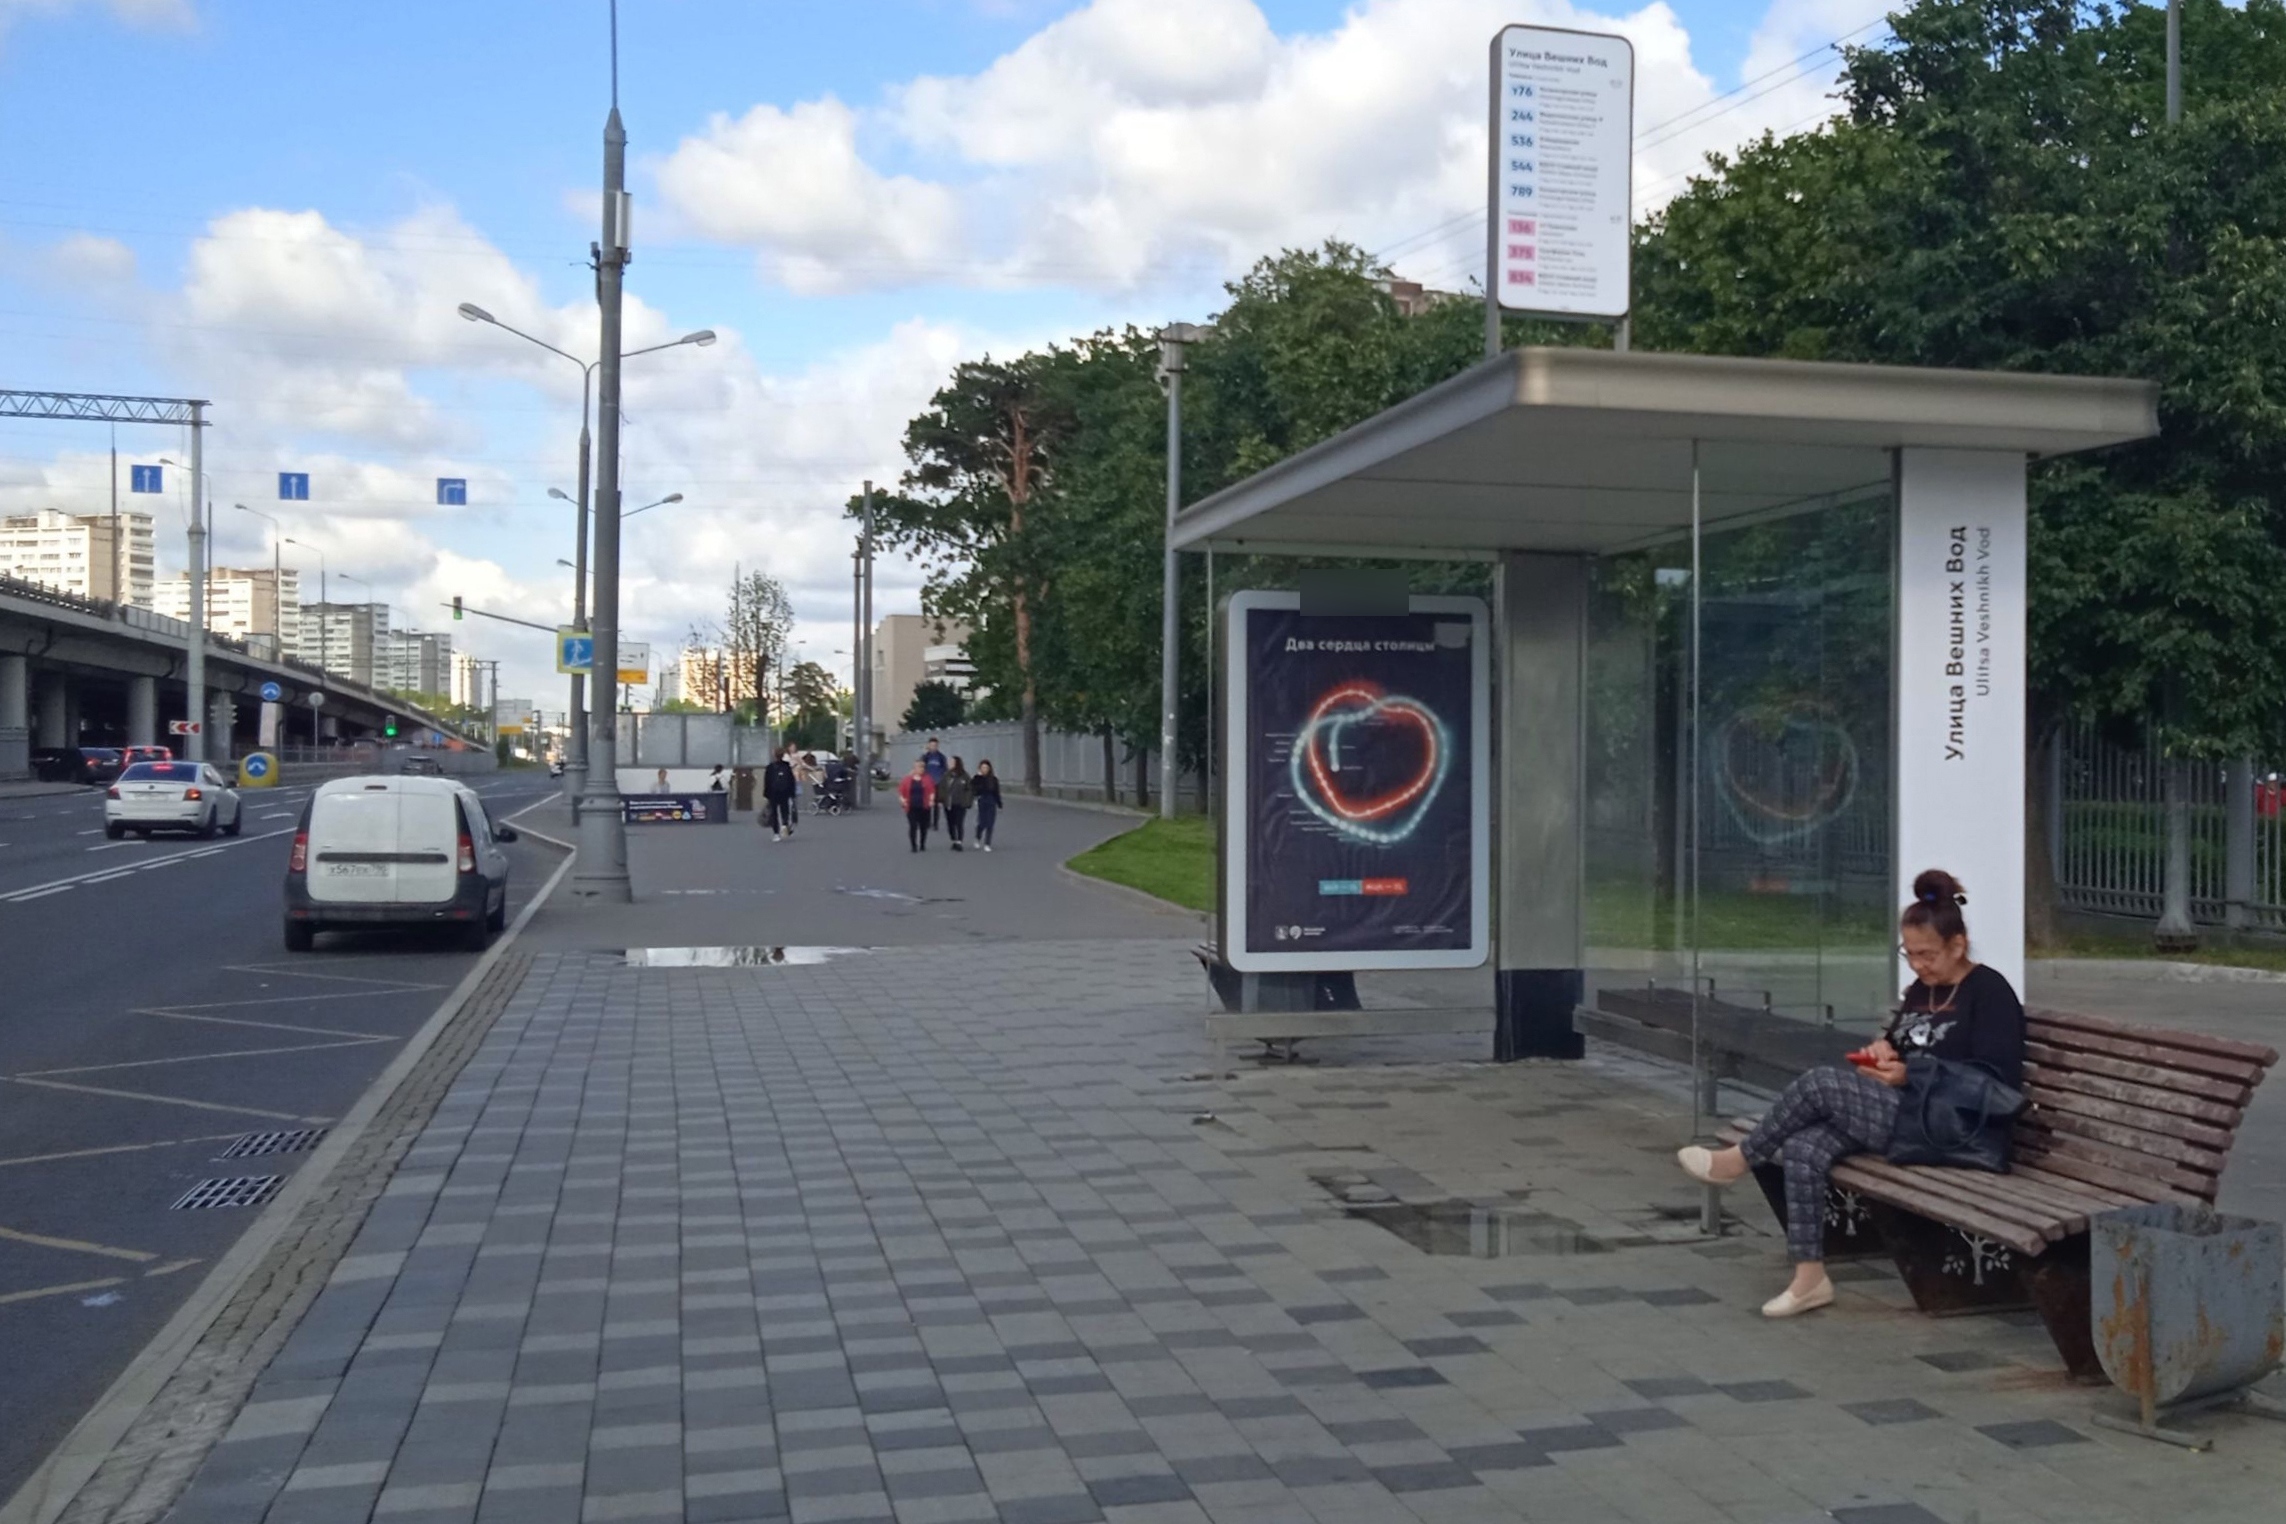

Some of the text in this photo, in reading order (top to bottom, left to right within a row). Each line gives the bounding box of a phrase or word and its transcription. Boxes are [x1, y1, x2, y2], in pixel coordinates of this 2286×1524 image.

[1509, 47, 1541, 60] Улица
[1587, 55, 1608, 68] Вод
[1511, 110, 1534, 122] 244
[1511, 135, 1534, 147] 536
[1511, 160, 1533, 172] 544
[1511, 185, 1533, 198] 789
[1976, 527, 1991, 697] Ulitsa Veshnikh Vod
[1285, 637, 1436, 653] Два сердца столицы
[1945, 526, 1967, 761] Улица Вешних Вод
